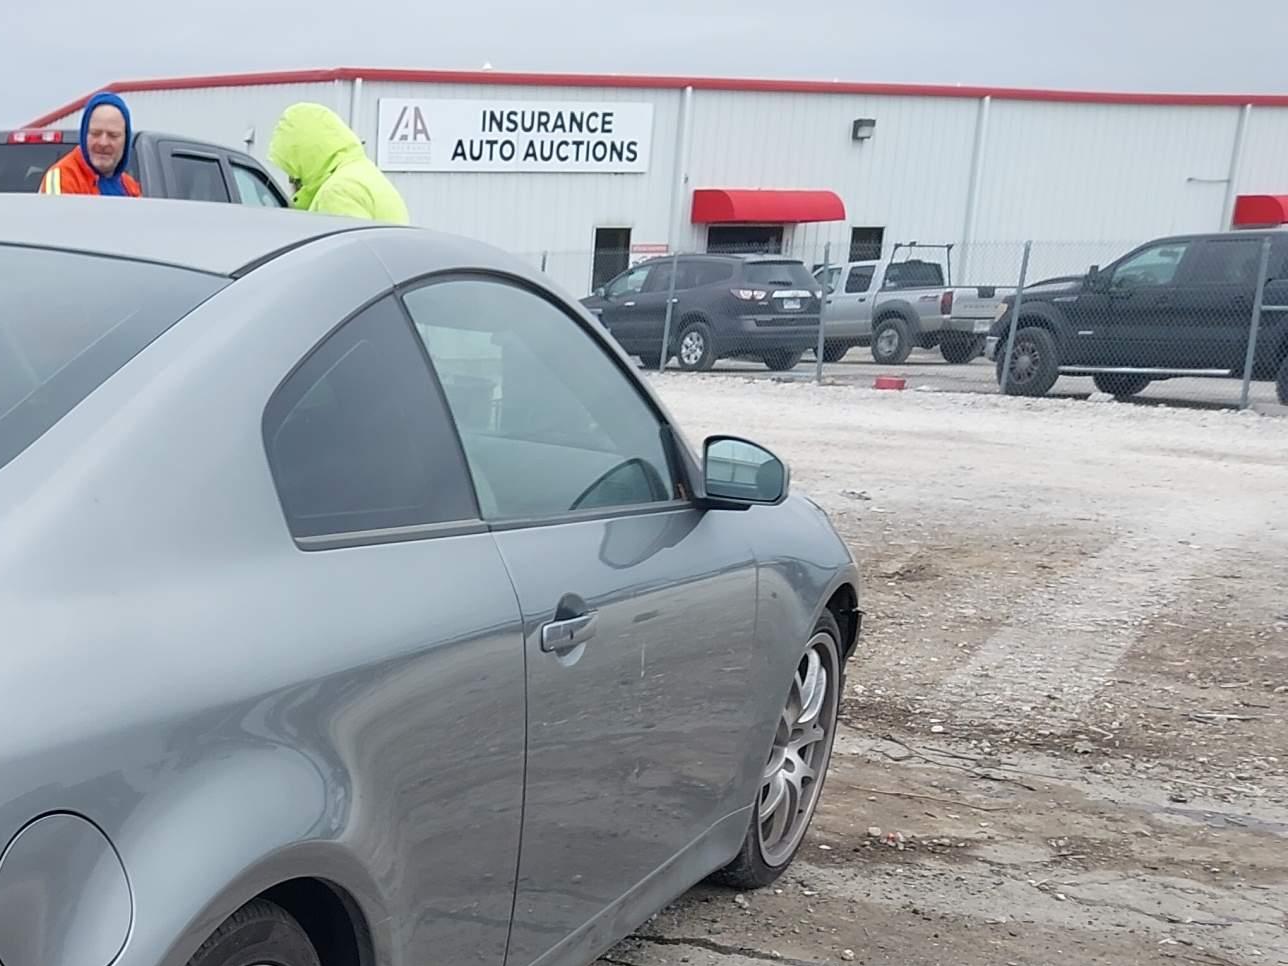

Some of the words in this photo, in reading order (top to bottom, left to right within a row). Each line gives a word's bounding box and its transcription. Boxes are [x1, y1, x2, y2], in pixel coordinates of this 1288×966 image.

[481, 110, 614, 134] INSURANCE
[451, 139, 516, 162] AUTO
[522, 140, 638, 162] AUCTIONS
